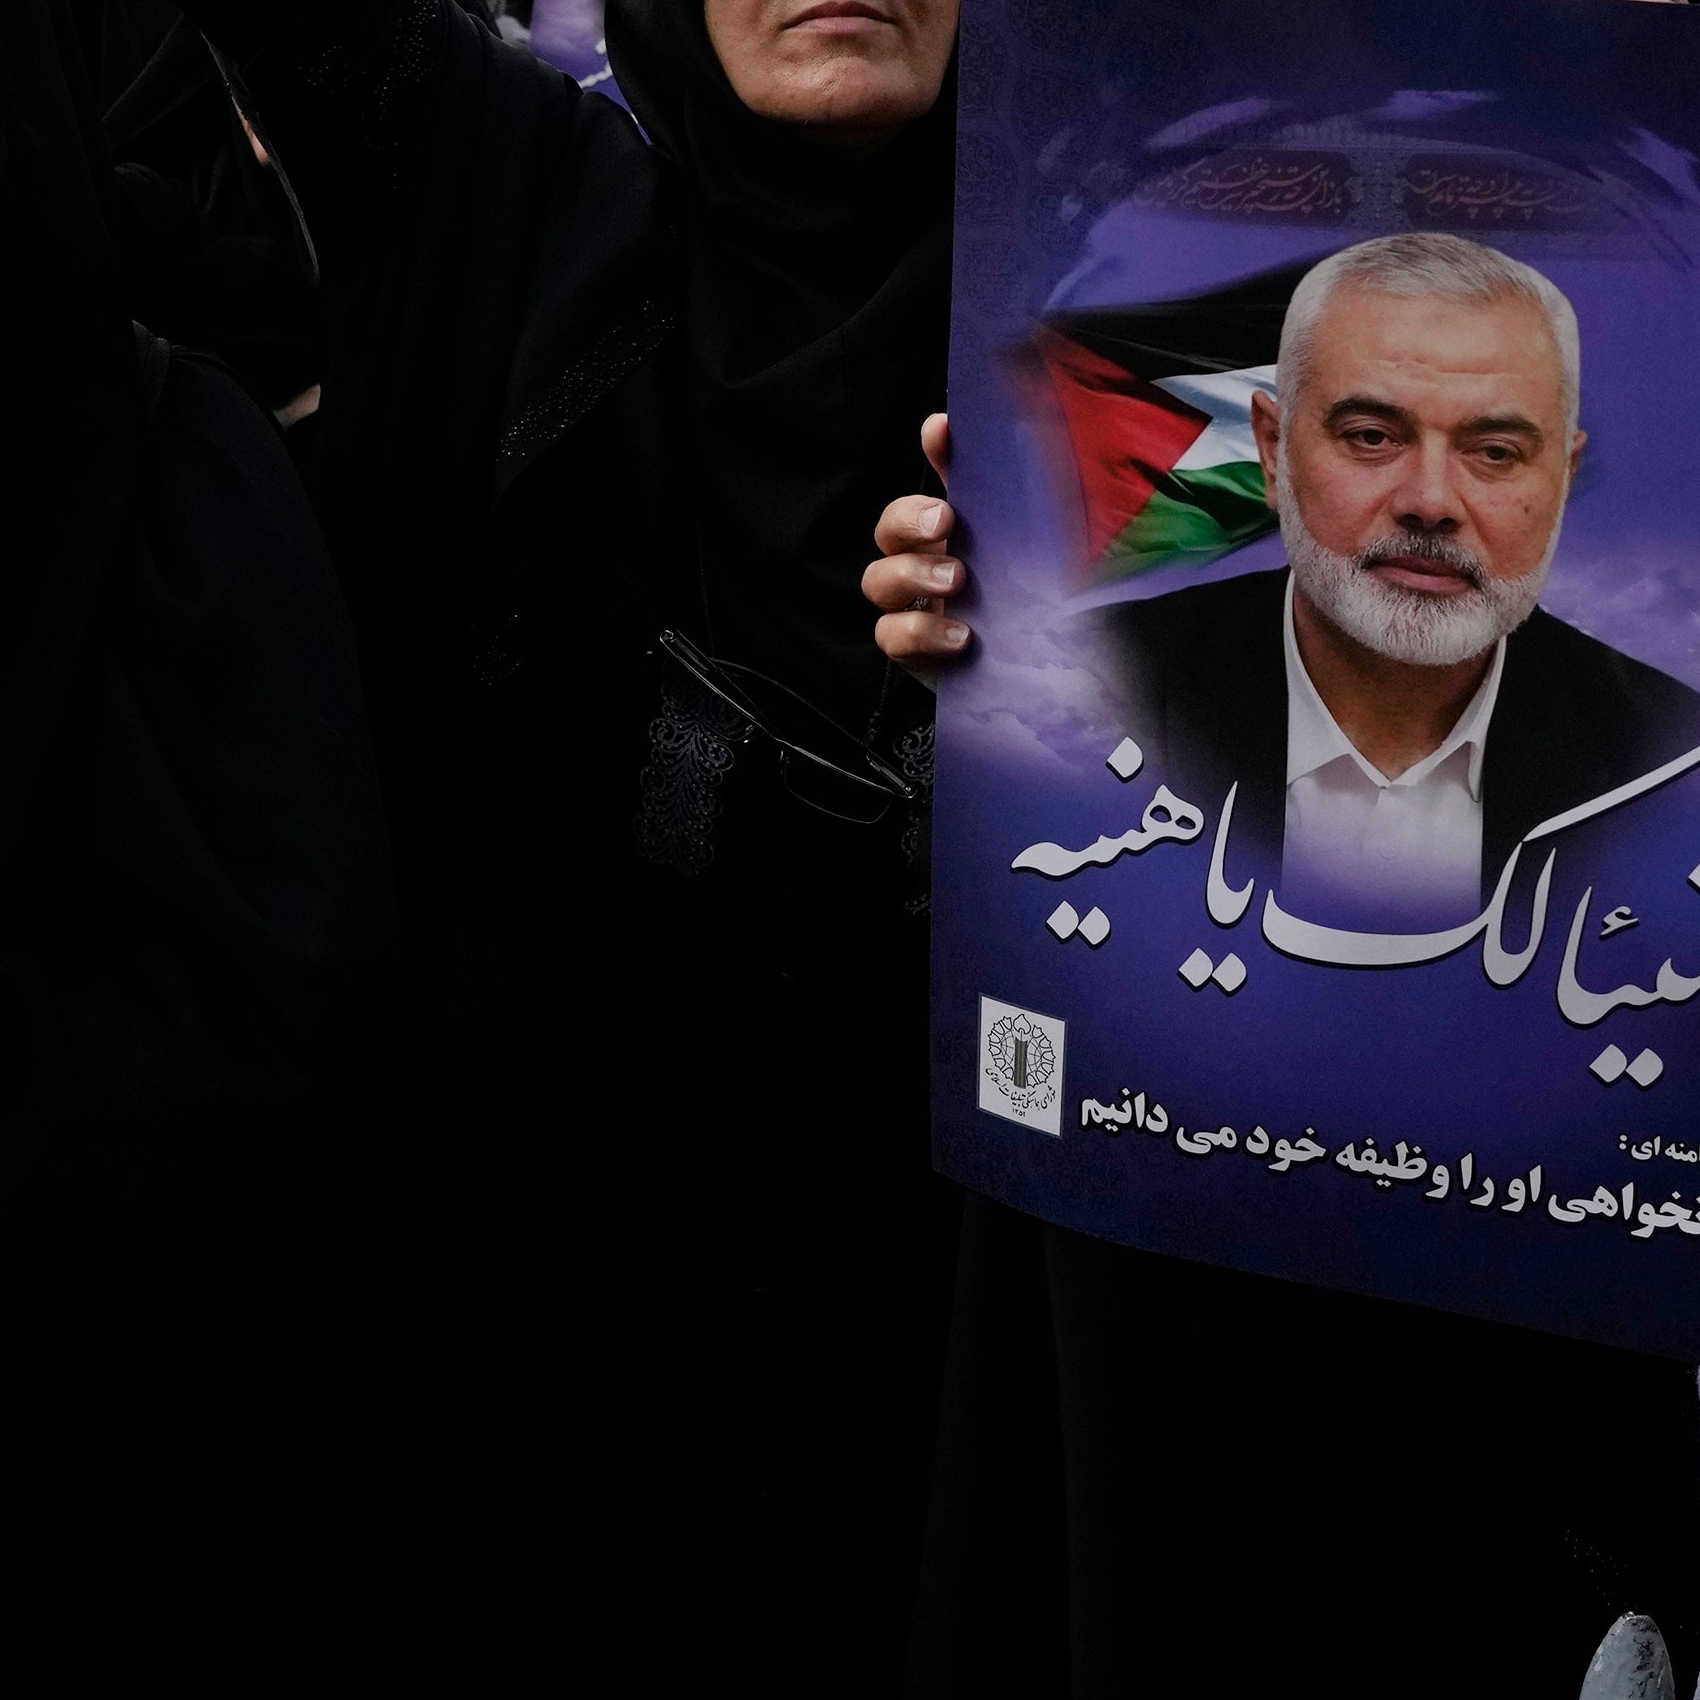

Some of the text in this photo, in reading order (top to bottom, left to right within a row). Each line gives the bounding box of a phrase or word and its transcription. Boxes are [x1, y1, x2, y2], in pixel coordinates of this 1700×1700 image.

[1180, 781, 1256, 992] یا
[1081, 1088, 1169, 1132] دانیم
[1176, 1126, 1238, 1154] می
[1246, 1125, 1327, 1171] خود
[1619, 1135, 1661, 1160] ای:
[1336, 1138, 1450, 1199] وظیفه
[1460, 1153, 1495, 1206] را
[1501, 1164, 1542, 1212] او
